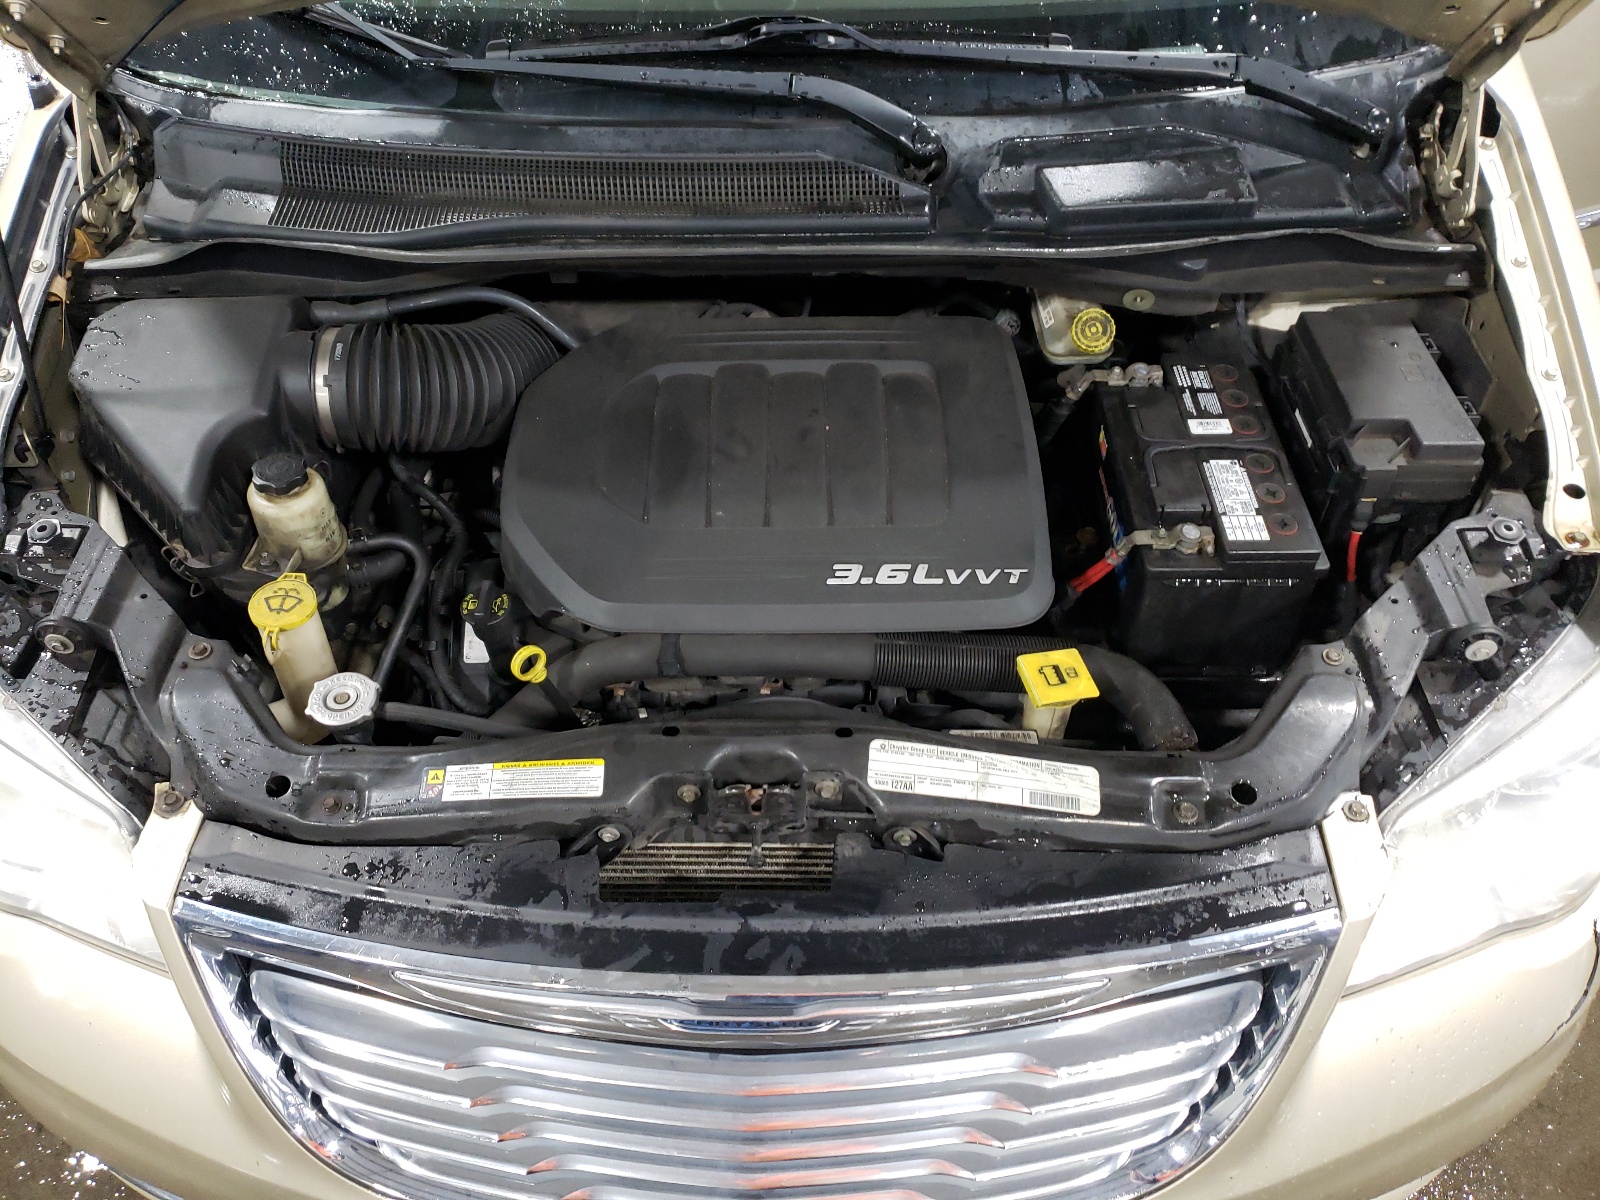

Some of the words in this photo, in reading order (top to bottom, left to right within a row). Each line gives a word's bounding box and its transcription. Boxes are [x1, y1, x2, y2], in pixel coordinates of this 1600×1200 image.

[889, 743, 909, 752] Chrysler
[910, 745, 925, 754] Group
[926, 746, 936, 754] LLC
